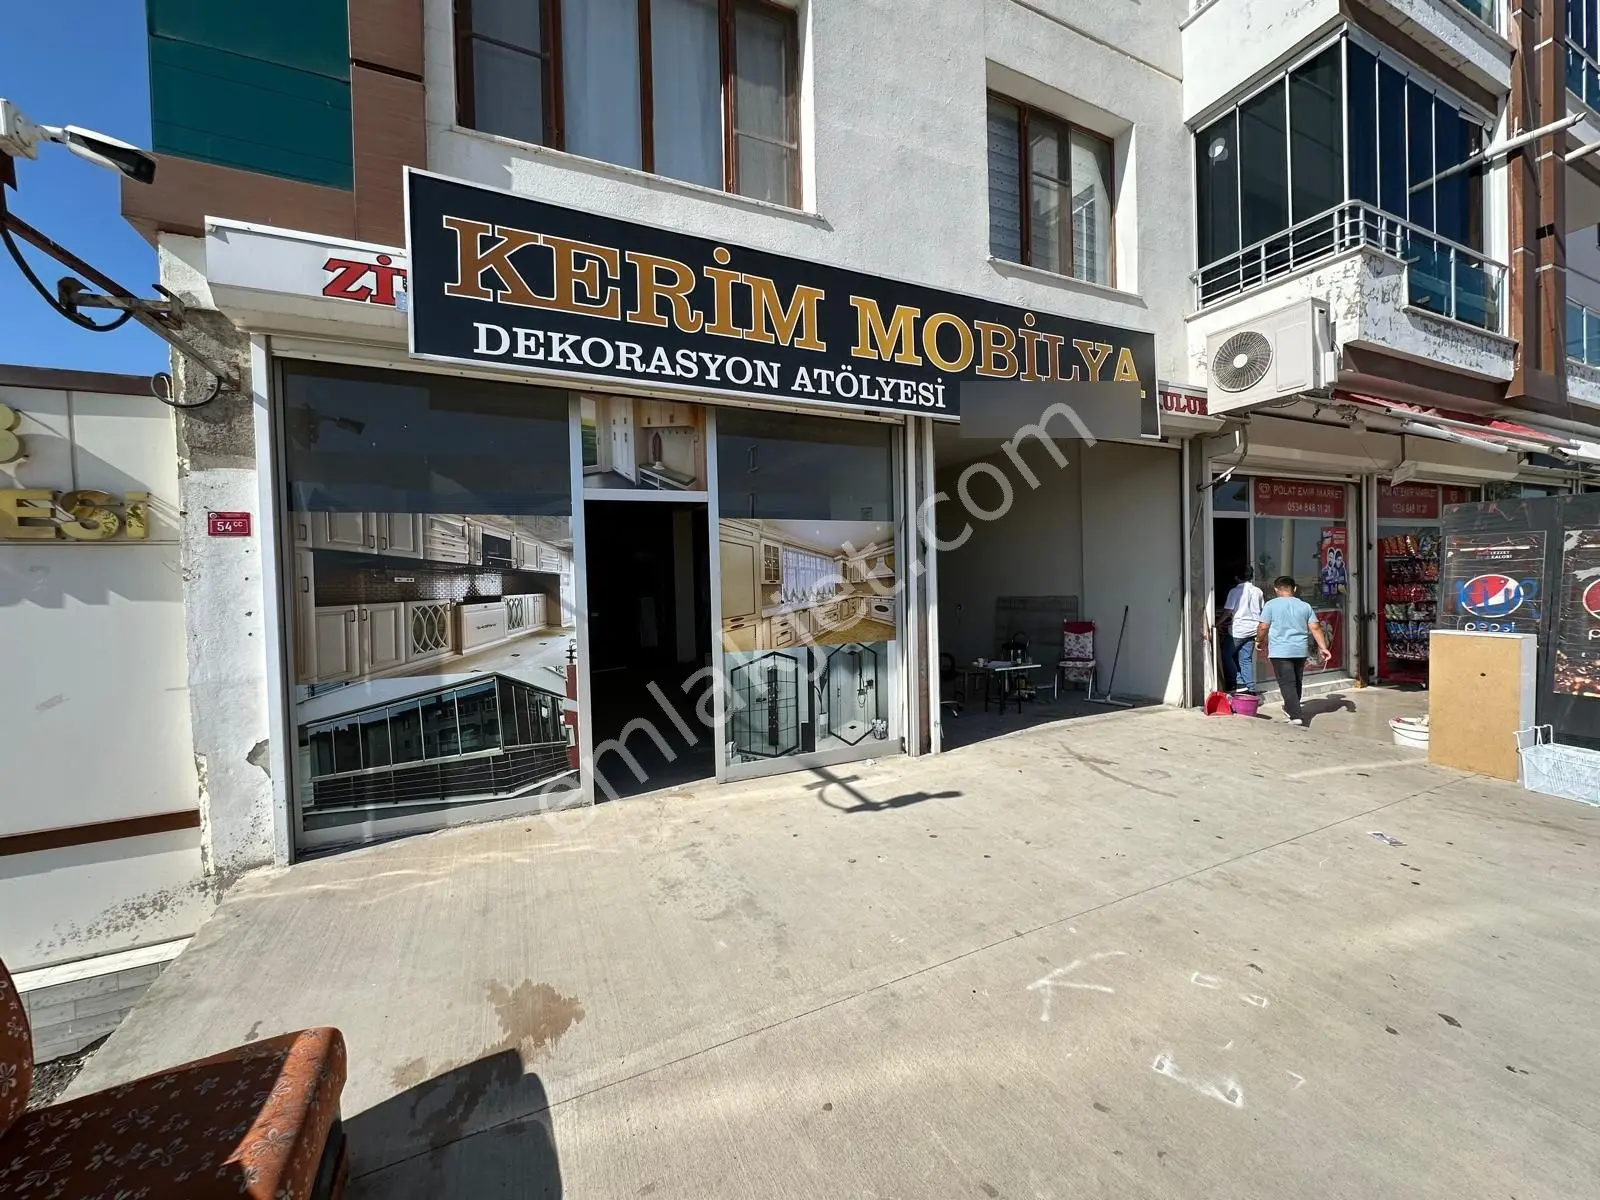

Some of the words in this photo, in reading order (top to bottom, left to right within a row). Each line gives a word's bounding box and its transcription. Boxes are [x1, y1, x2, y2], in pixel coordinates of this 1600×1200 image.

[322, 254, 407, 306] Zİ
[442, 214, 827, 353] KERİM
[849, 294, 1146, 399] MOBİLYA
[472, 321, 781, 389] DEKORASYON
[790, 364, 946, 409] ATÖLYESİ
[1273, 484, 1296, 496] POLAT
[1316, 488, 1343, 499] MARKET
[1287, 501, 1303, 512] 0534
[1464, 621, 1516, 633] pepsi
